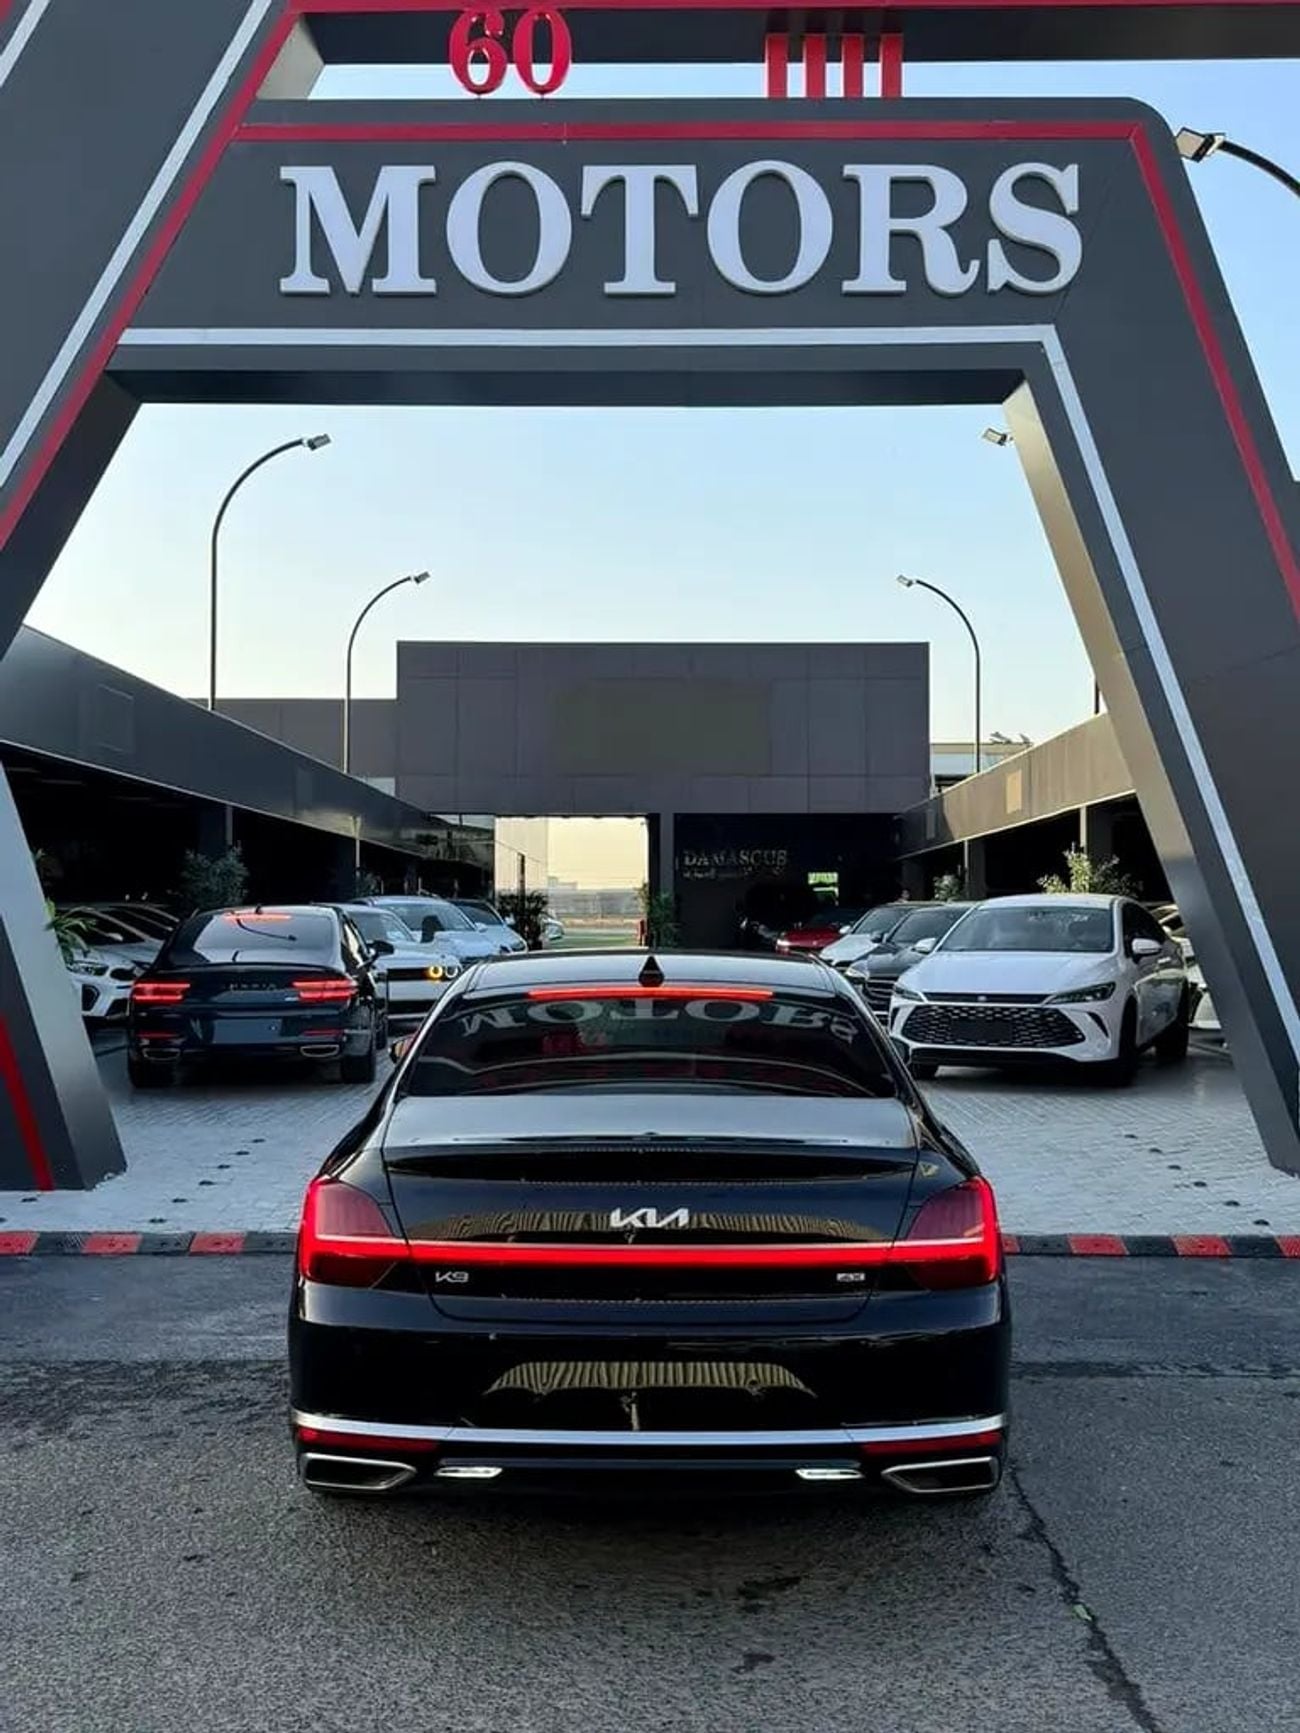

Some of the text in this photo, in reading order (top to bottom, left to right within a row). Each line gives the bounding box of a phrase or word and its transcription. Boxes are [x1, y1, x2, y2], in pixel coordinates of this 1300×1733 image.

[449, 7, 572, 95] 60
[279, 160, 1083, 297] MOTORS
[610, 1207, 689, 1228] KIA
[435, 1271, 469, 1283] K9
